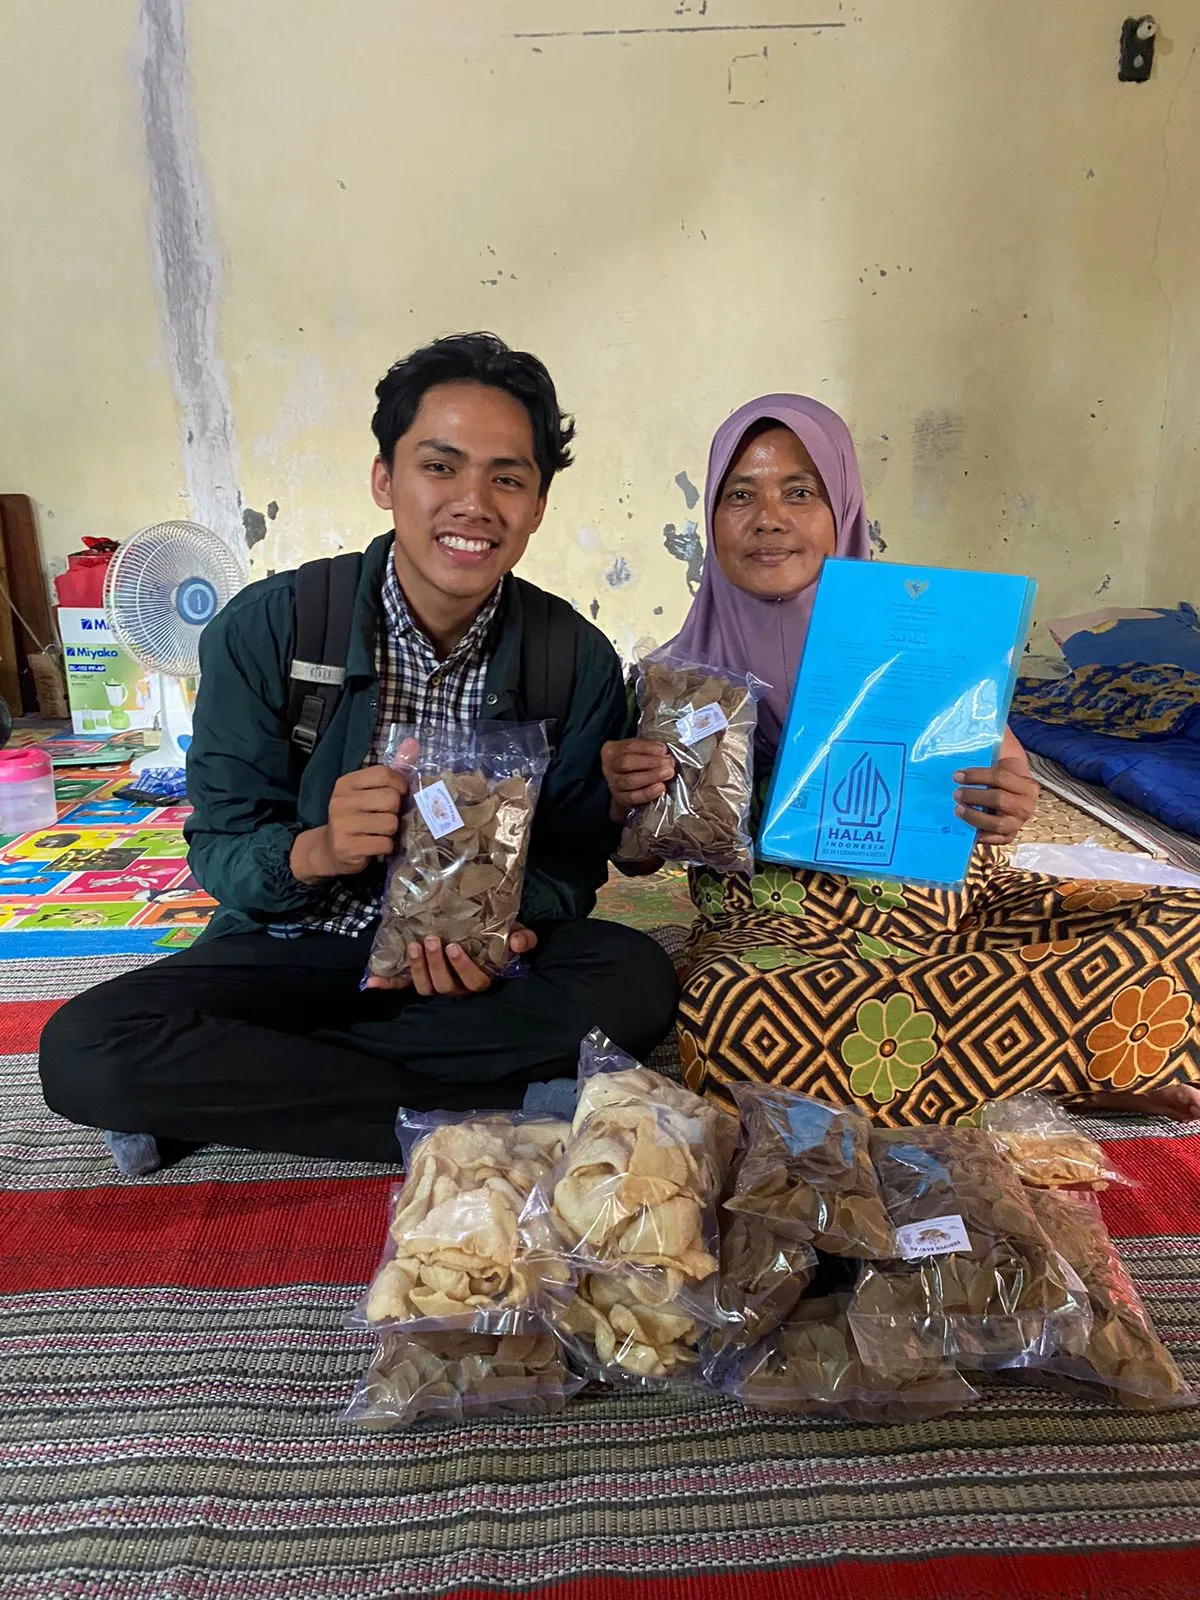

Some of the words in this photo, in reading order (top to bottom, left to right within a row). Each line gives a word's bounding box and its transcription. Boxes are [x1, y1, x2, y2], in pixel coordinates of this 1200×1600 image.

[77, 647, 118, 660] Miyako
[828, 827, 885, 842] HALAL
[825, 841, 884, 850] INDONESIA
